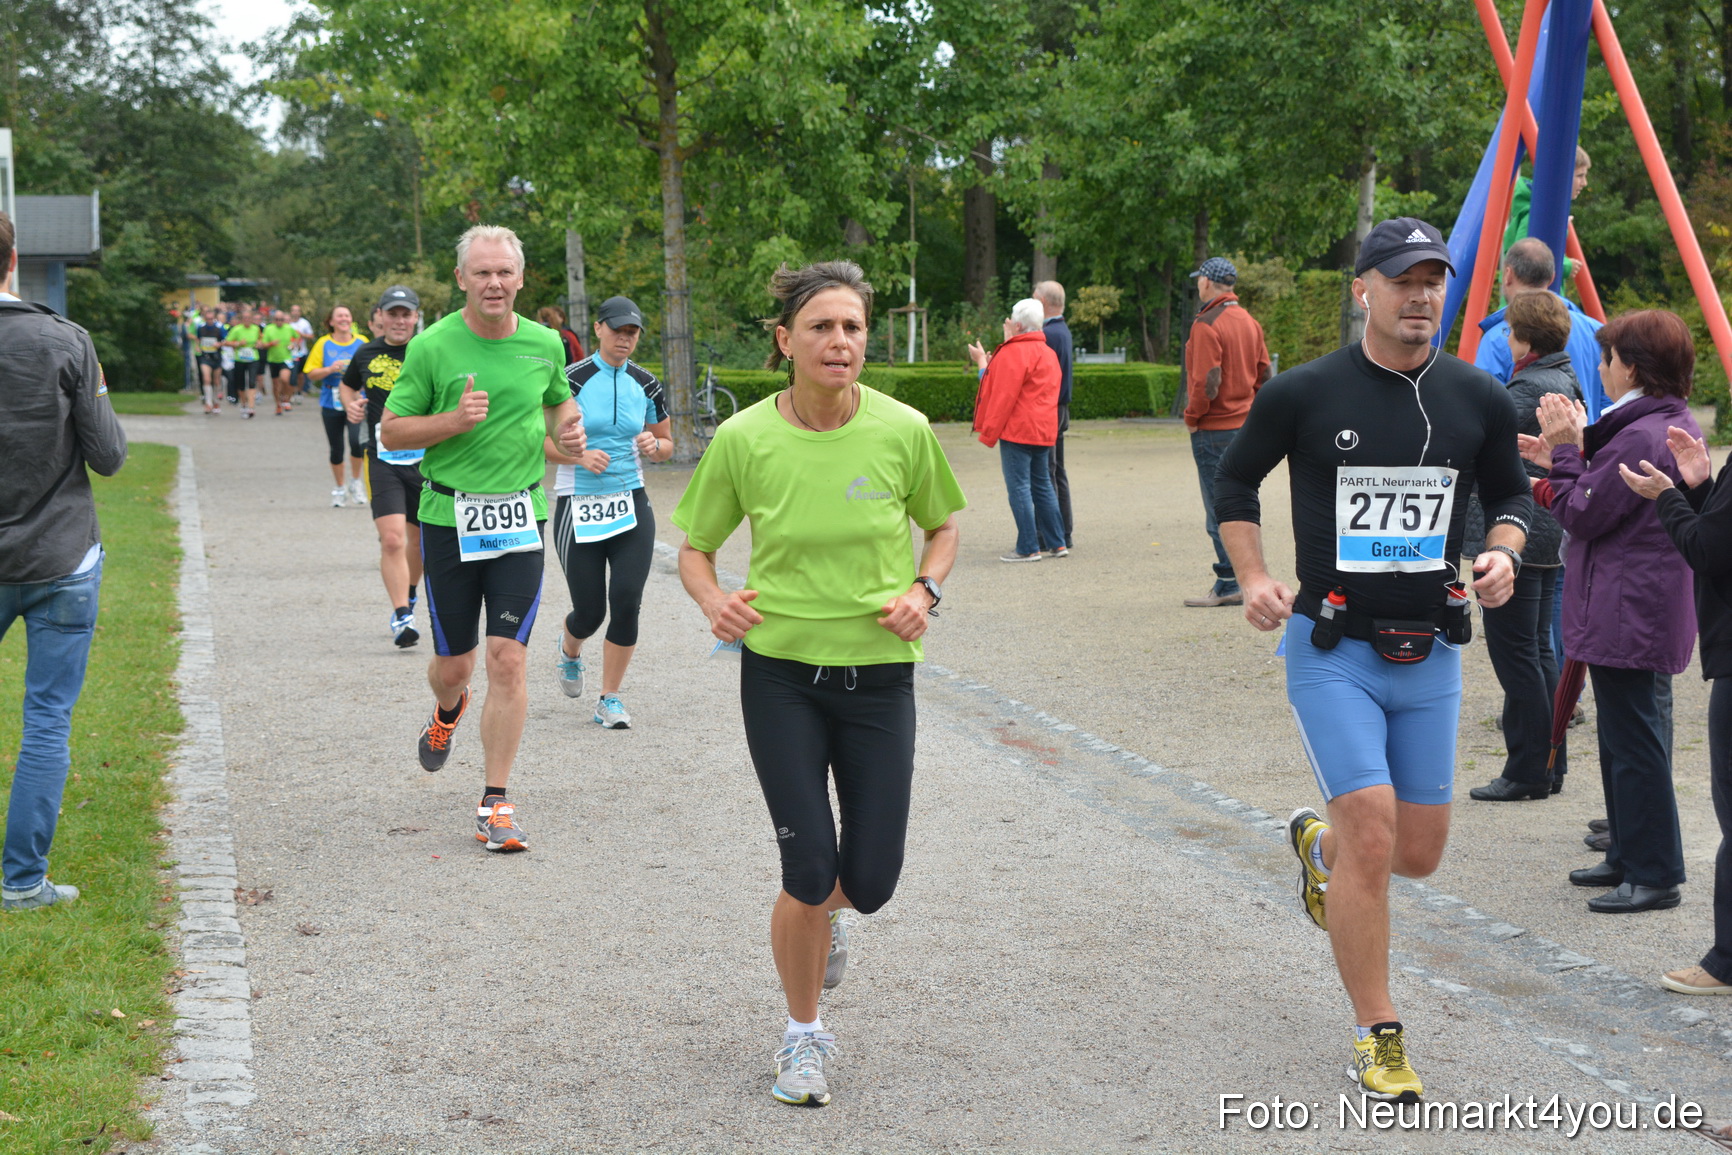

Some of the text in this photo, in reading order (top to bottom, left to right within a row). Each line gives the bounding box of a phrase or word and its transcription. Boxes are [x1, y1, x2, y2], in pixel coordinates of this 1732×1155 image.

[1340, 477, 1437, 488] PARTL Neumarkt
[484, 494, 518, 504] Neumarkt
[464, 501, 528, 532] 2699
[579, 500, 629, 522] 3349
[1349, 492, 1445, 532] 2757
[479, 537, 520, 549] Andreas
[1371, 541, 1420, 558] Gerald
